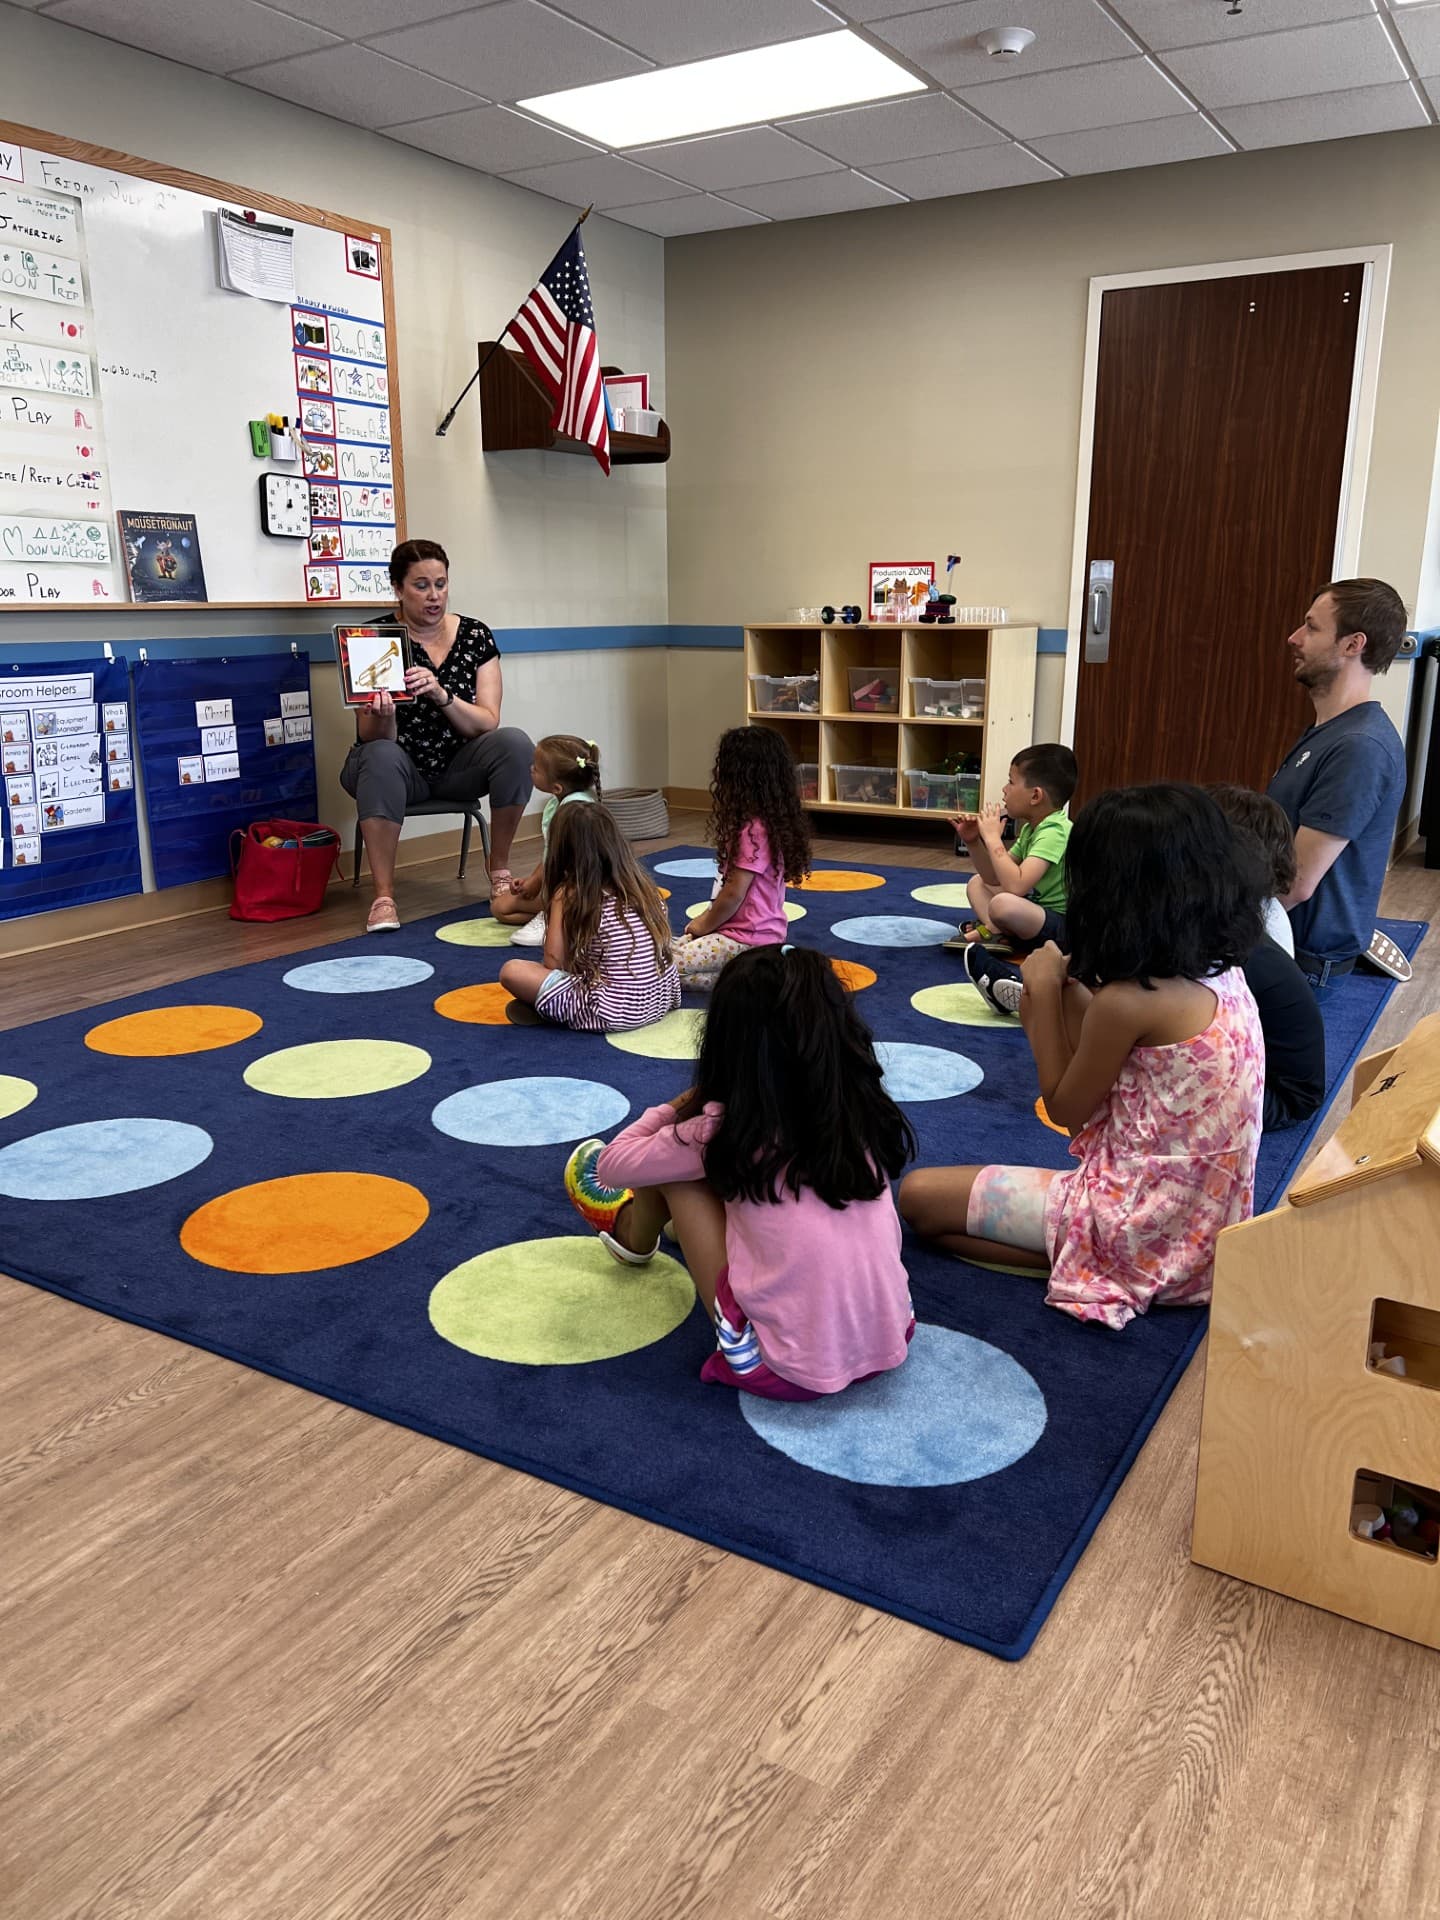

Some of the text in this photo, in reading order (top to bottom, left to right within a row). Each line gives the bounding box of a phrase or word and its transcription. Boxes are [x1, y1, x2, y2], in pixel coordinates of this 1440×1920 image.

[44, 273, 79, 300] TRIP
[11, 397, 52, 424] PLAY
[66, 473, 100, 490] CHILL
[126, 517, 193, 531] MOUSETRONAUT
[908, 567, 931, 576] ZONE
[26, 573, 61, 598] PLAY
[36, 685, 77, 698] Helpers
[64, 807, 92, 816] Gardener
